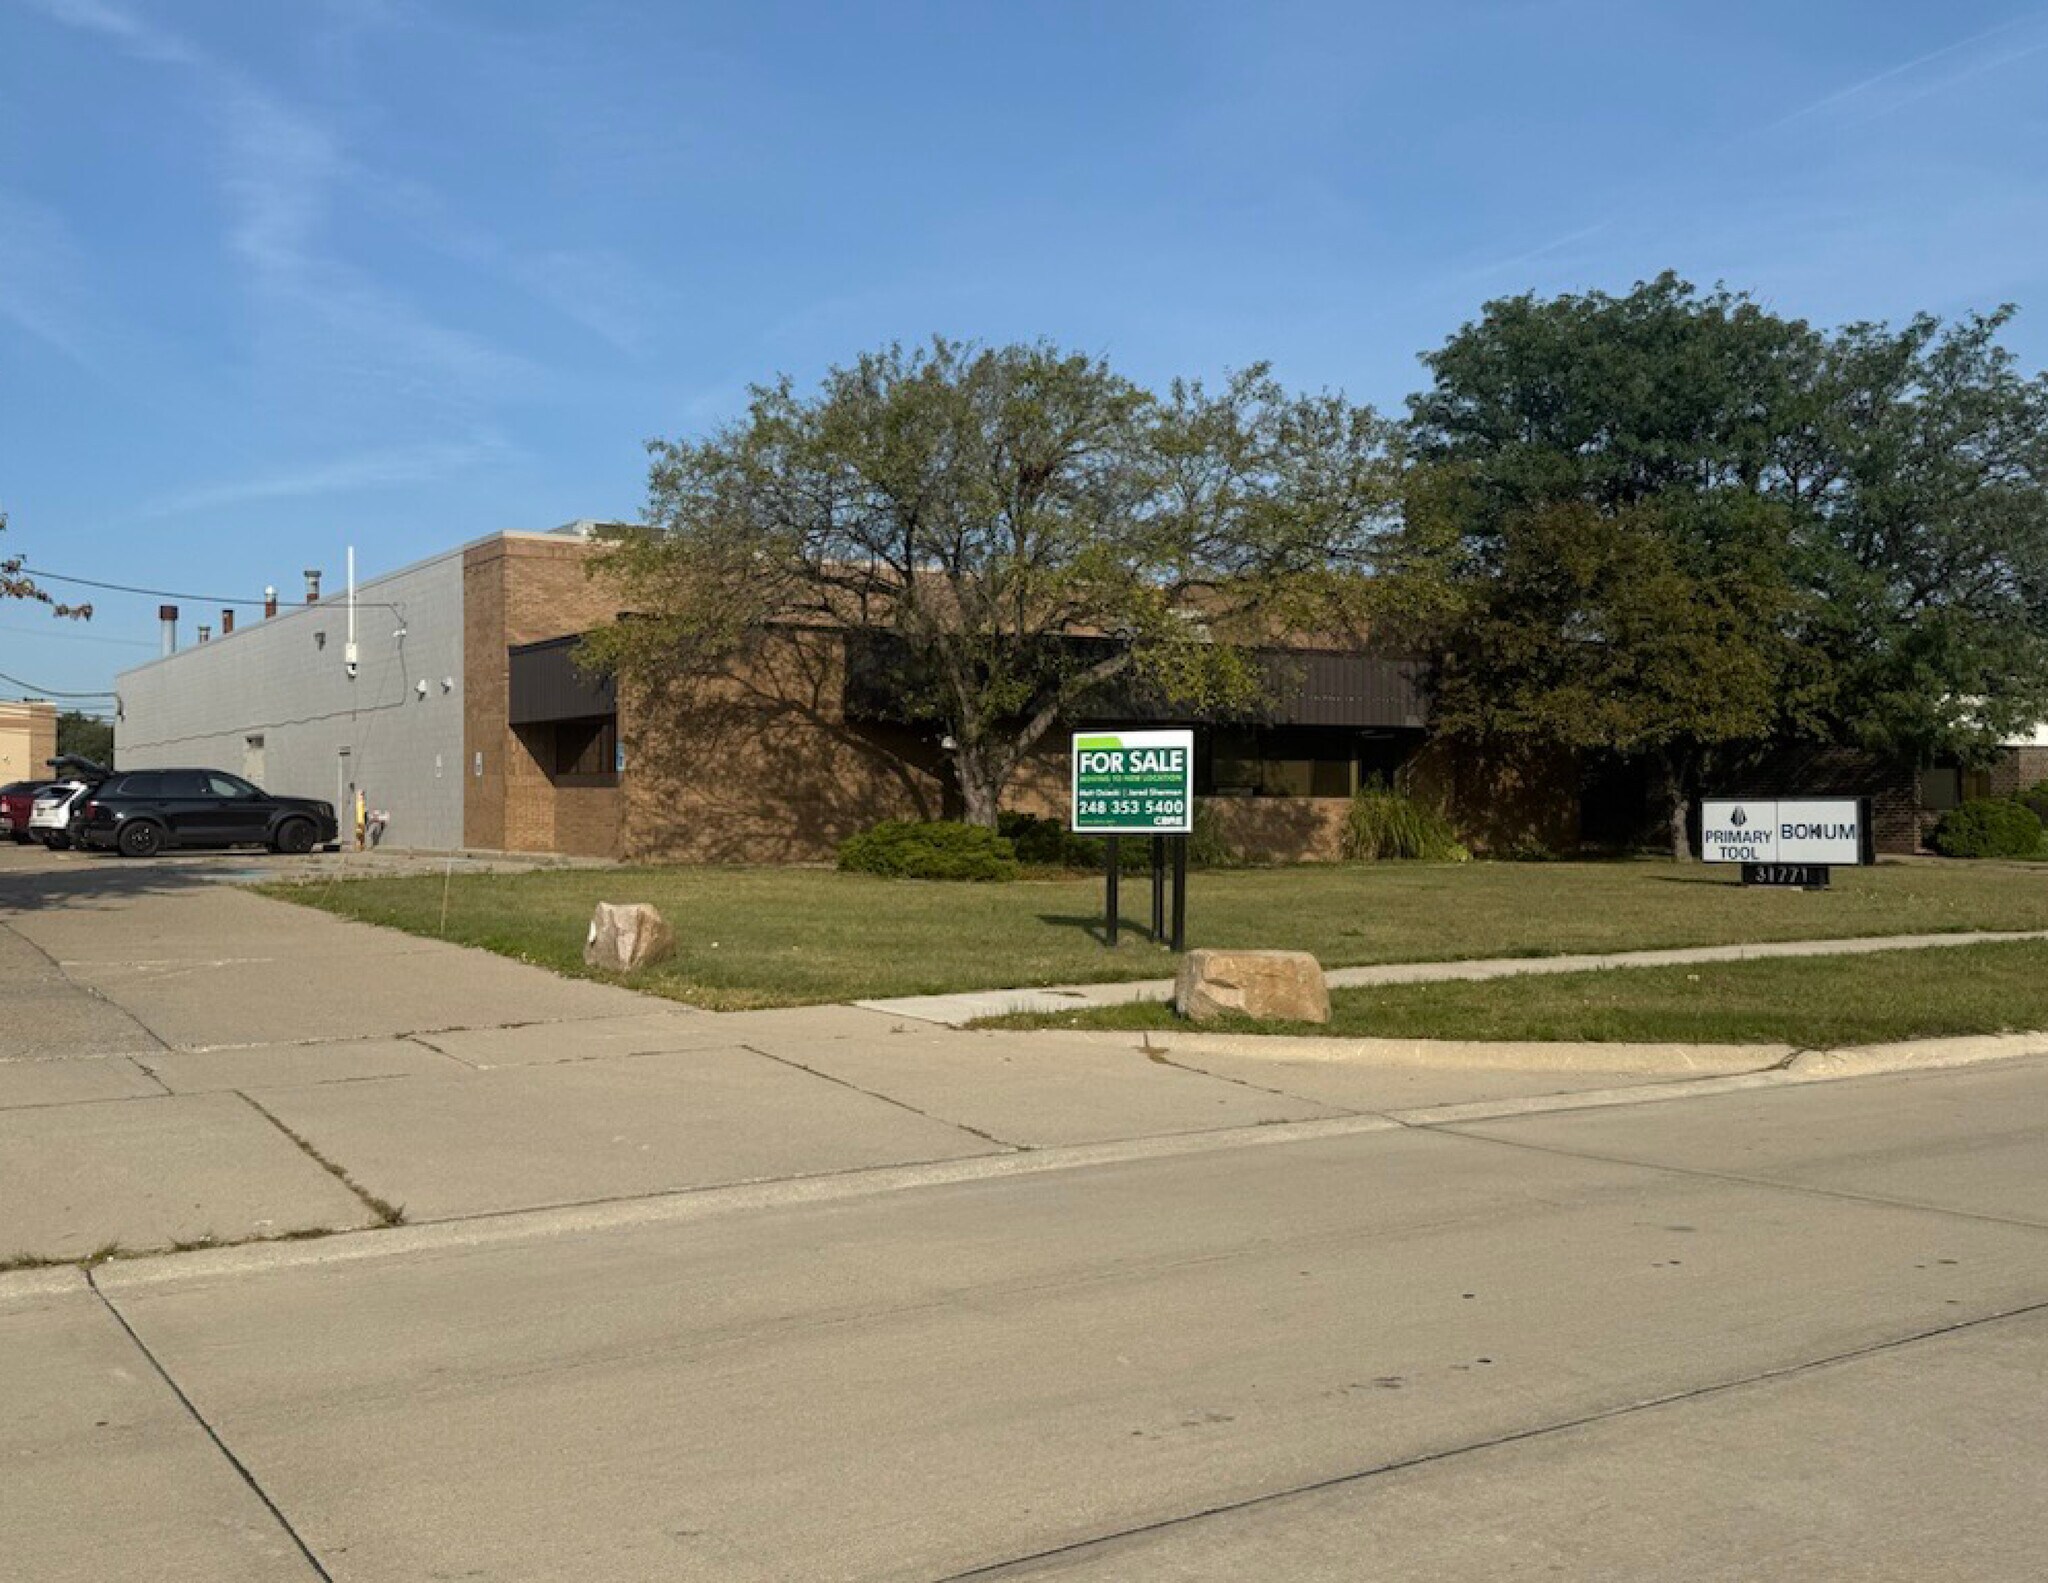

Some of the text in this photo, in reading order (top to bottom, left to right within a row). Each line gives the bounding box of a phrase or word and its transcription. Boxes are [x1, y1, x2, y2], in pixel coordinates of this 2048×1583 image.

[1081, 750, 1183, 774] FOR SALE
[1079, 799, 1183, 814] 248 353 5400
[1705, 830, 1772, 844] PRIMARY
[1719, 846, 1760, 861] TOOL
[1755, 867, 1808, 882] 31771
